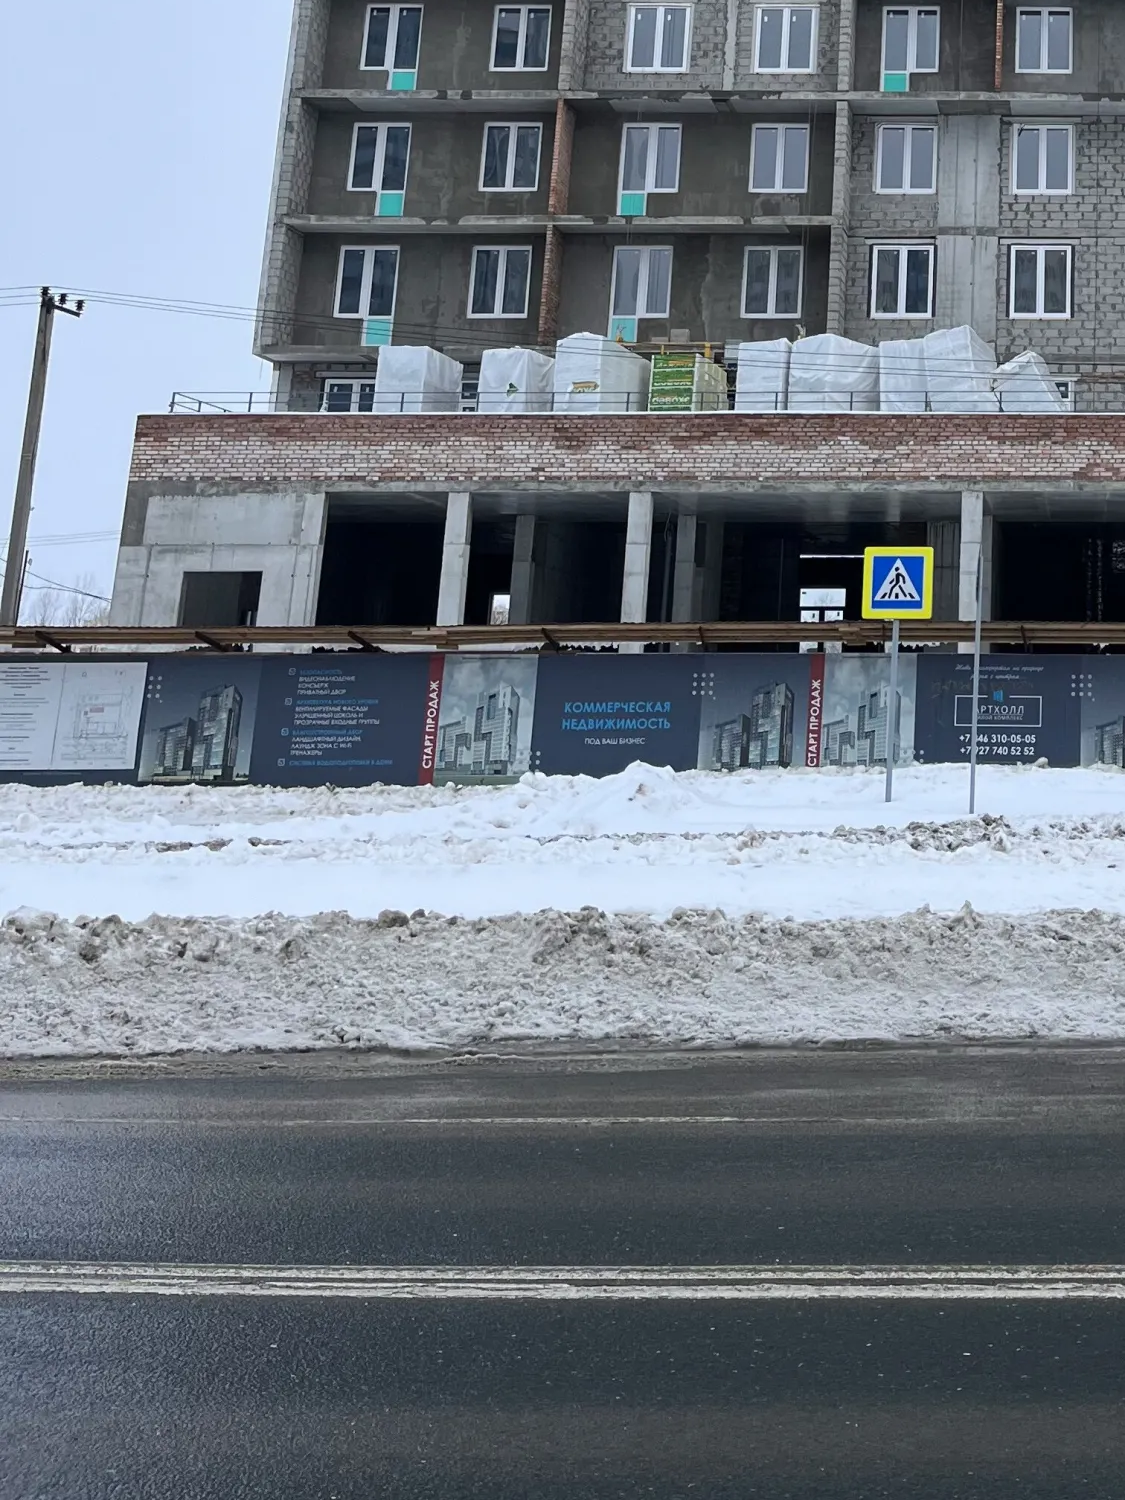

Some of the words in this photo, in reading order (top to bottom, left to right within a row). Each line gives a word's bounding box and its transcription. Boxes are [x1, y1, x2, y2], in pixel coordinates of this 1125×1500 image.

[426, 680, 439, 731] ПРОДАЖ
[565, 702, 671, 712] КОММЕРЧЕСКАЯ
[810, 680, 821, 730] ПРОДАЖ
[977, 706, 1024, 714] РТХОЛЛ
[562, 719, 670, 730] НЕДВИЖИМОСТЬ
[975, 735, 988, 743] 46
[991, 735, 1036, 743] 310-05-05
[423, 736, 434, 768] СТАРТ
[808, 733, 818, 766] СТАРТ
[960, 747, 971, 755] +7
[992, 747, 1008, 755] 740
